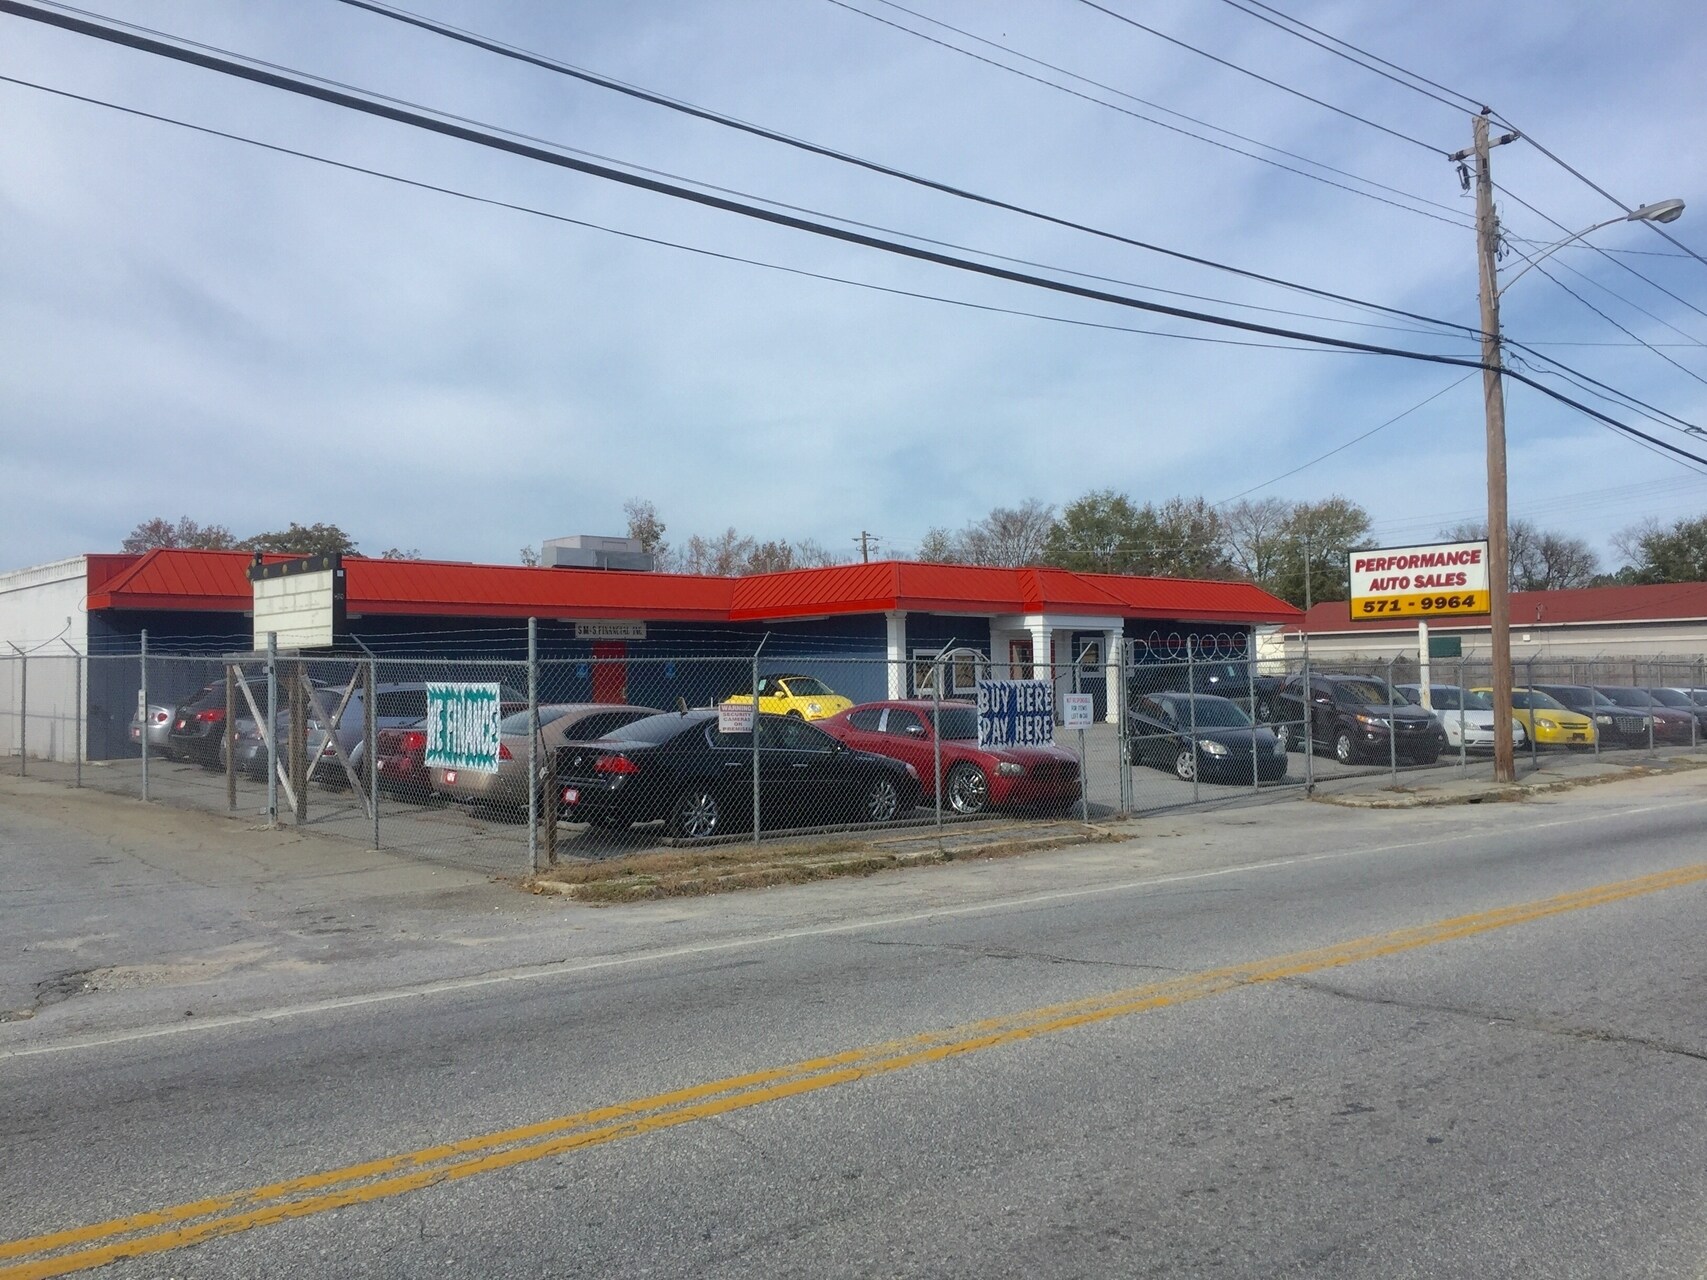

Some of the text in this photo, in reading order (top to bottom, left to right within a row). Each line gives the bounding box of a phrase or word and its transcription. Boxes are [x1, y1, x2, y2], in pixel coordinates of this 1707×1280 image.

[1355, 549, 1481, 573] PERFORMANCE
[1369, 572, 1467, 591] AUTO SALES
[1363, 600, 1401, 613] 571
[1421, 595, 1475, 609] 9964
[980, 687, 1052, 714] BUY HERE
[982, 715, 1051, 743] PAY HERE
